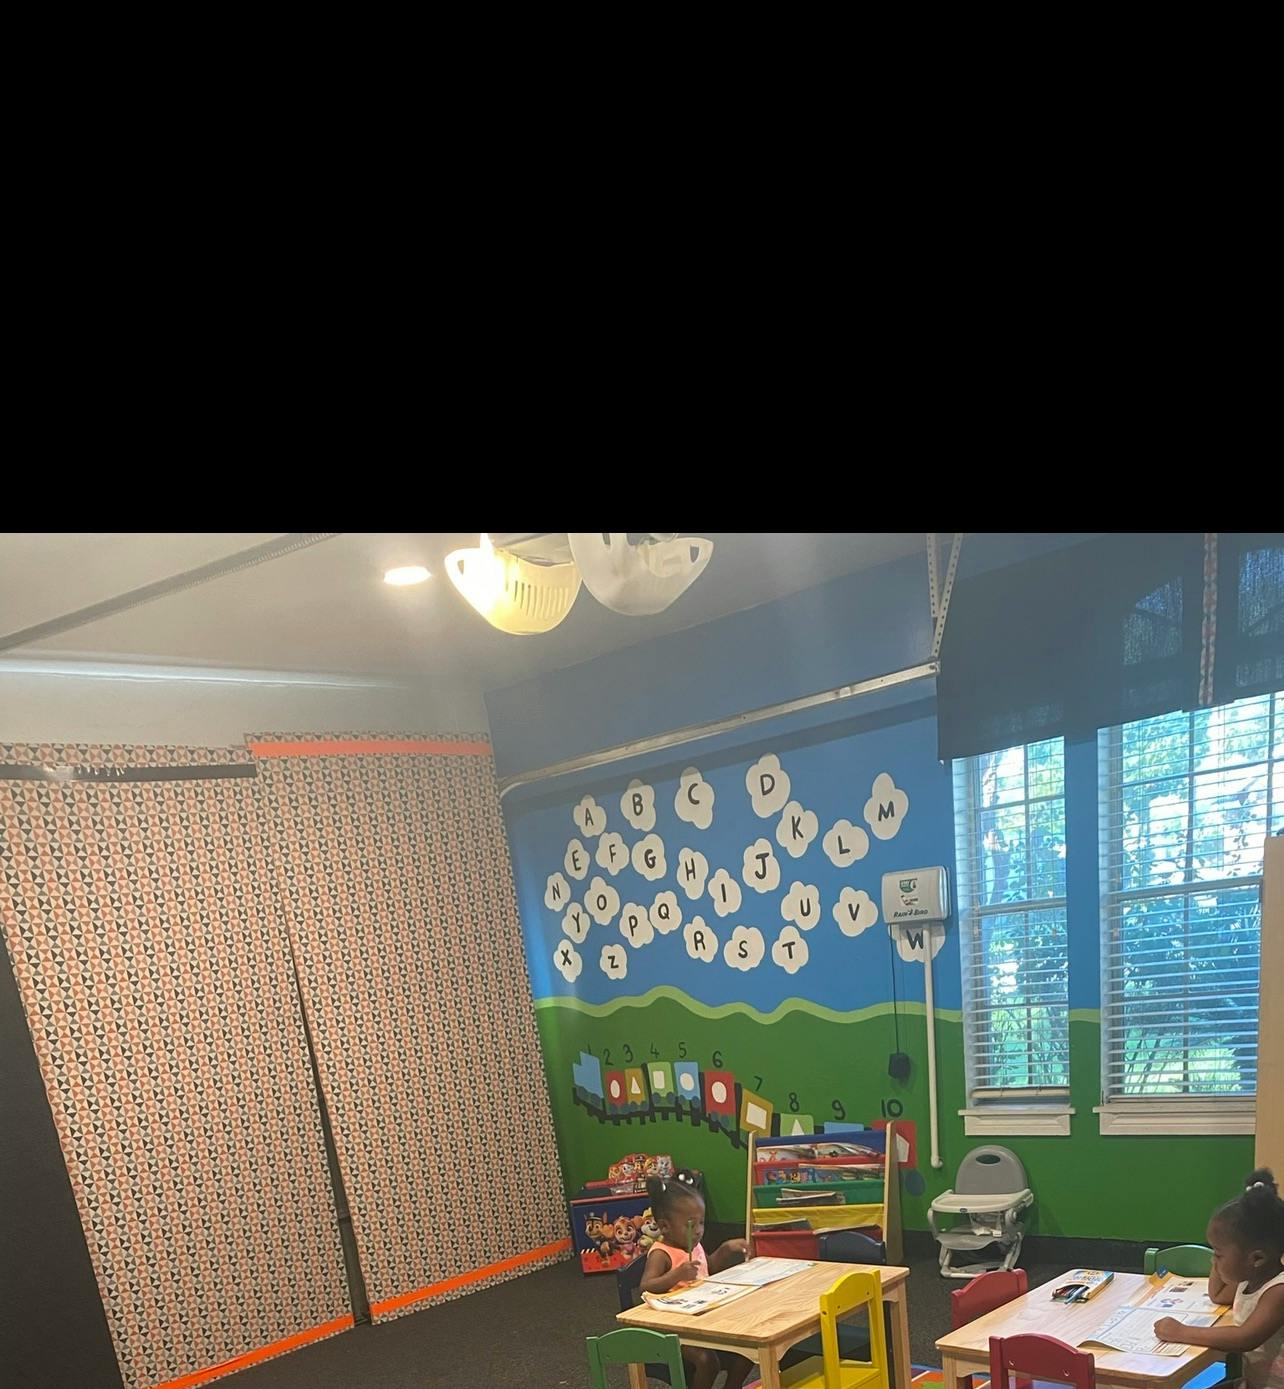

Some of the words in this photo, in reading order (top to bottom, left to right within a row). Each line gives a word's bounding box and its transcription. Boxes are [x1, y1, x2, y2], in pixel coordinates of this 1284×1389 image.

[585, 807, 594, 827] A
[632, 792, 644, 817] B
[687, 782, 700, 806] C
[759, 773, 776, 796] D
[571, 849, 582, 872] E
[608, 843, 617, 863] F
[644, 848, 657, 870] G
[684, 857, 696, 881] H
[720, 883, 727, 903] I
[754, 852, 770, 880] J
[791, 815, 804, 841] K
[837, 835, 851, 855] L
[877, 800, 895, 822] M
[552, 882, 561, 901] N
[596, 894, 608, 911] O
[628, 914, 638, 937] P
[657, 902, 670, 920] Q
[693, 930, 706, 951] R
[737, 940, 748, 959] S
[781, 941, 796, 960] T
[800, 898, 811, 917] U
[847, 903, 860, 922] V
[561, 949, 572, 967] X
[572, 913, 582, 934] Y
[607, 955, 619, 969] Z
[603, 1048, 614, 1066] 2
[622, 1044, 634, 1063] 3
[650, 1042, 660, 1059] 4
[678, 1041, 687, 1059] 5
[712, 1050, 723, 1068] 6
[754, 1075, 763, 1092] 7
[788, 1092, 800, 1113] 8
[831, 1099, 846, 1121] 9
[881, 1098, 904, 1119] 10
